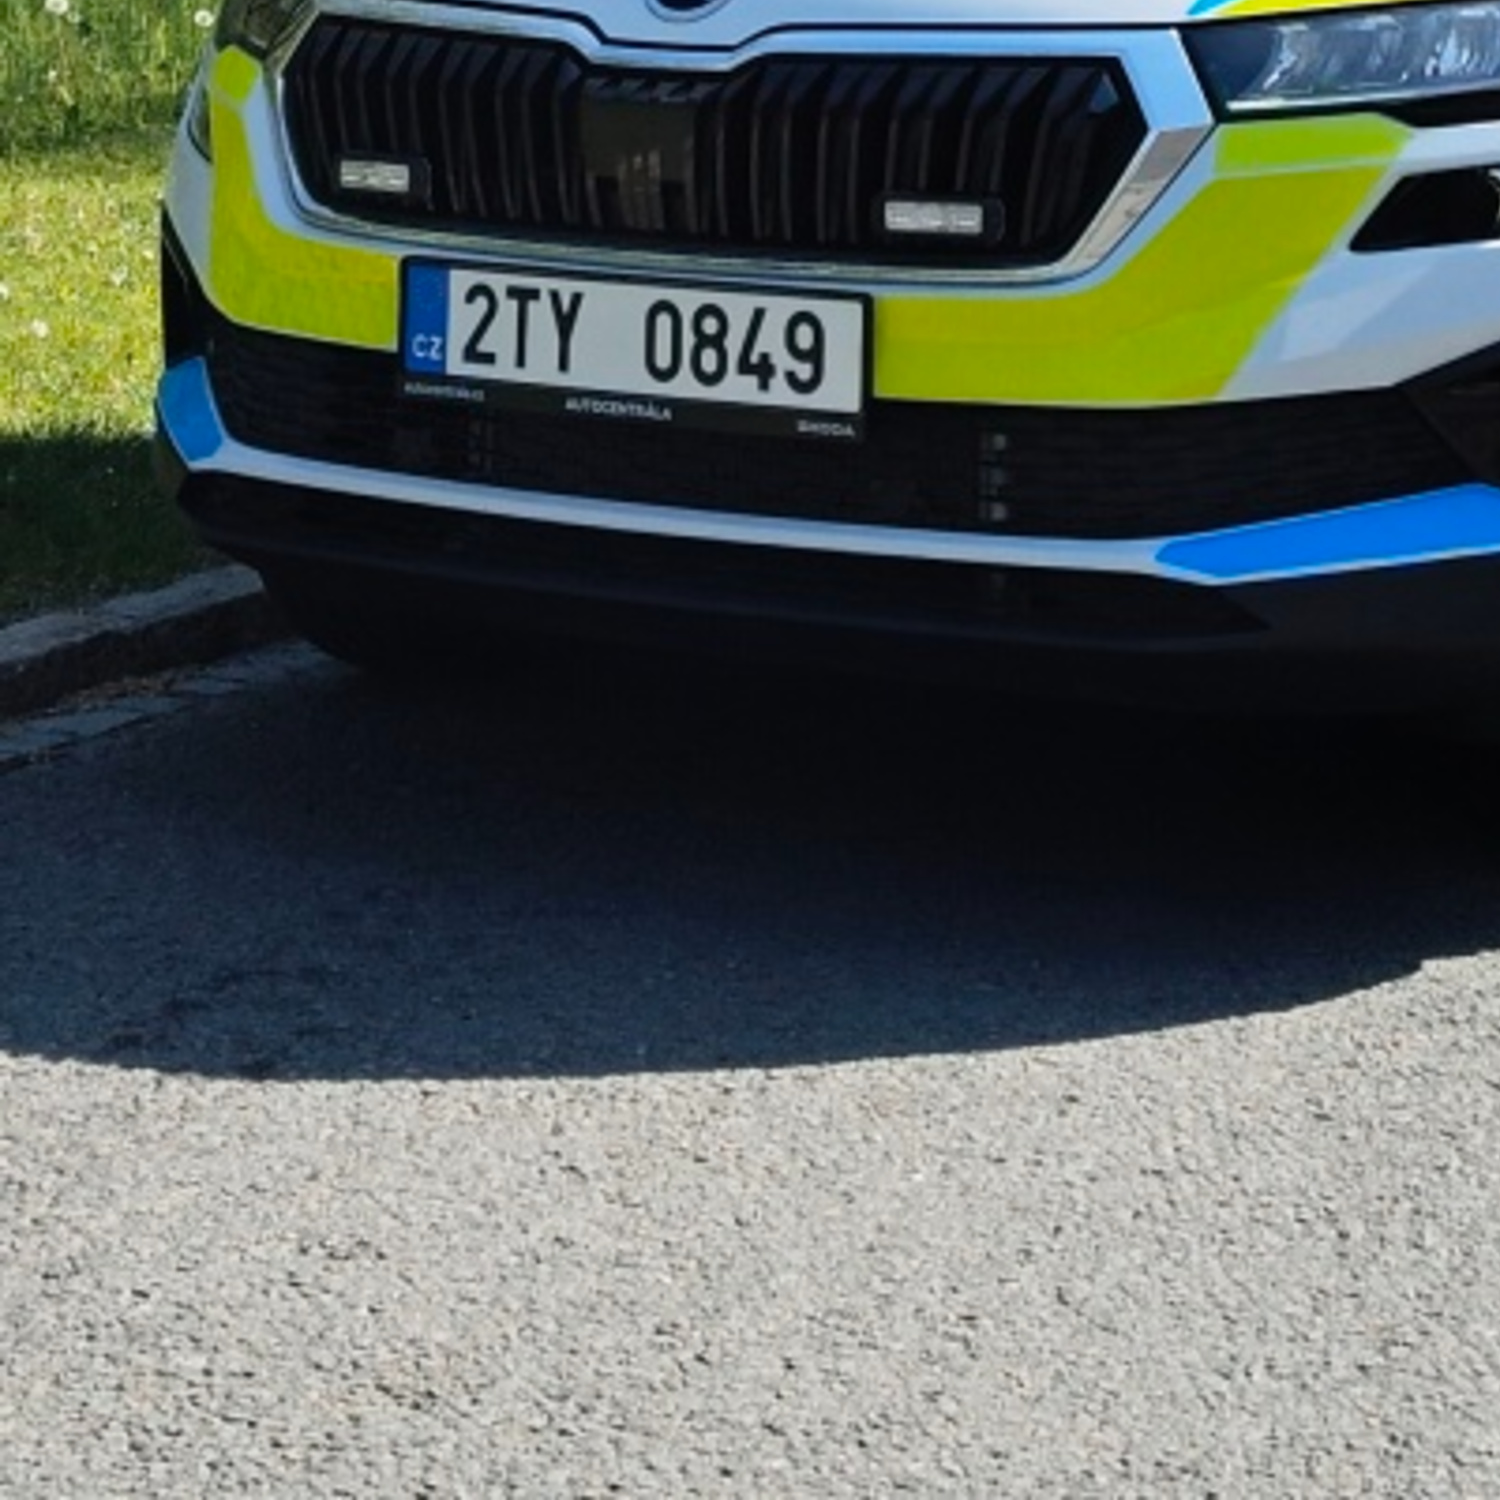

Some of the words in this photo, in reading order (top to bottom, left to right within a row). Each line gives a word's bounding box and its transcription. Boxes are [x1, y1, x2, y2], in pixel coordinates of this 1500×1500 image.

[412, 333, 443, 361] CZ
[462, 283, 584, 373] 2TY
[644, 299, 826, 395] 0849
